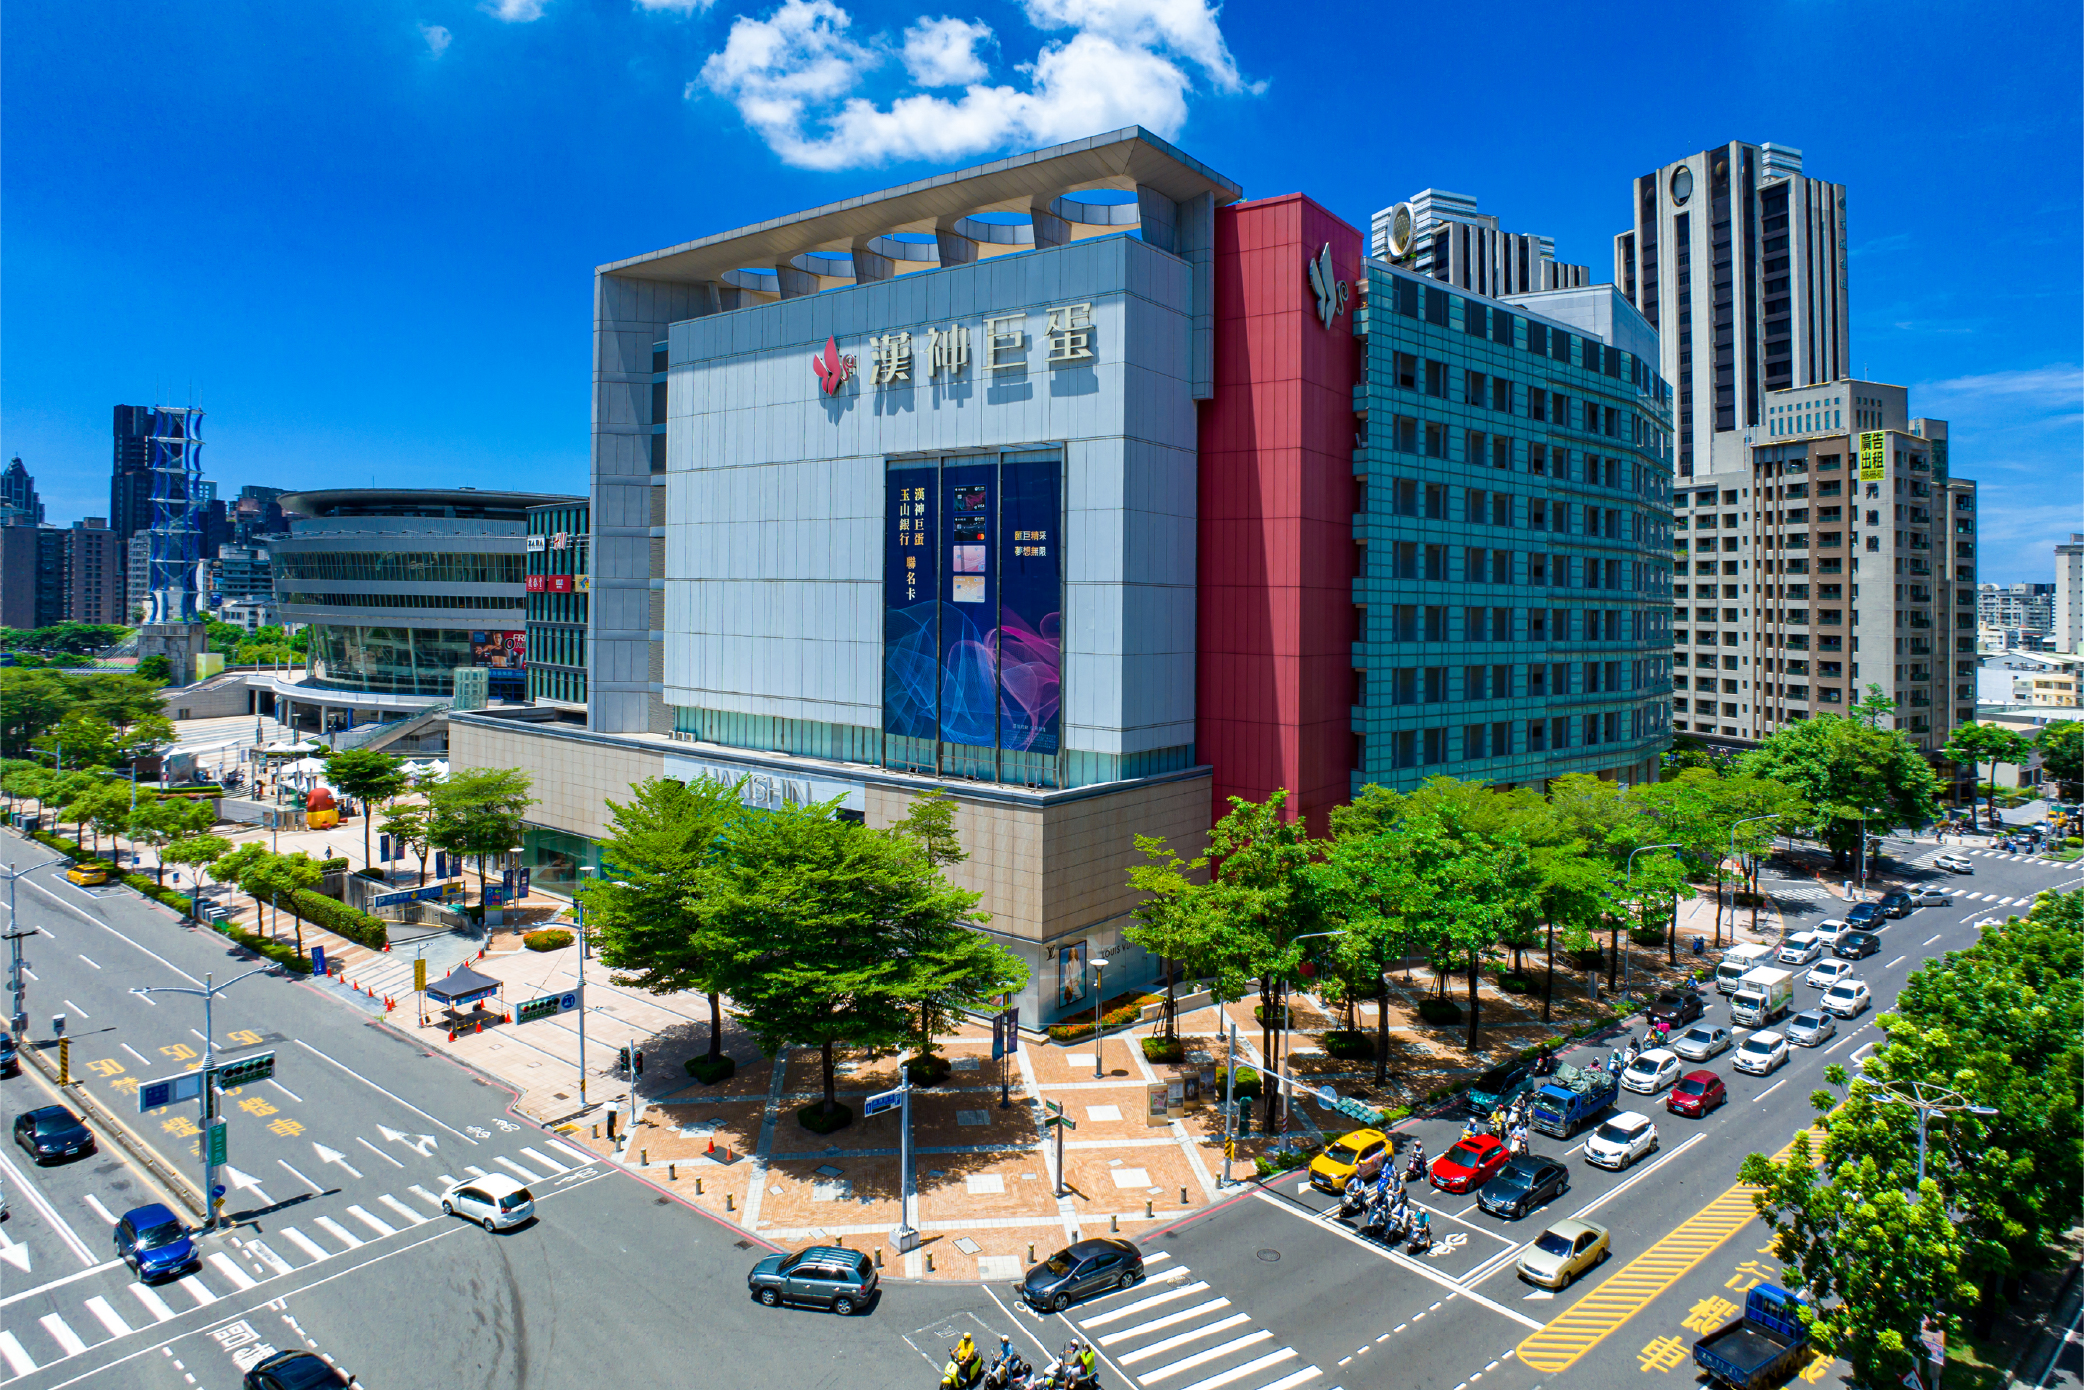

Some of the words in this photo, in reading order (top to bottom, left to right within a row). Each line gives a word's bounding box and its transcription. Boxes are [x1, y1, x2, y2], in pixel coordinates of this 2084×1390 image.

[869, 302, 1096, 385] 漢神巨蛋
[1861, 432, 1884, 451] 廣告
[1861, 451, 1884, 469] 出租
[899, 488, 910, 546] 玉山銀行
[914, 487, 925, 546] 漢神巨蛋
[528, 539, 544, 547] ZARA
[1014, 546, 1047, 557] 夢想無限
[905, 556, 917, 601] 聯名卡
[486, 888, 494, 896] P
[378, 897, 386, 906] P
[1101, 945, 1121, 959] LOUIS
[227, 1029, 263, 1046] 50
[159, 1043, 198, 1061] 50
[85, 1058, 126, 1077] 50
